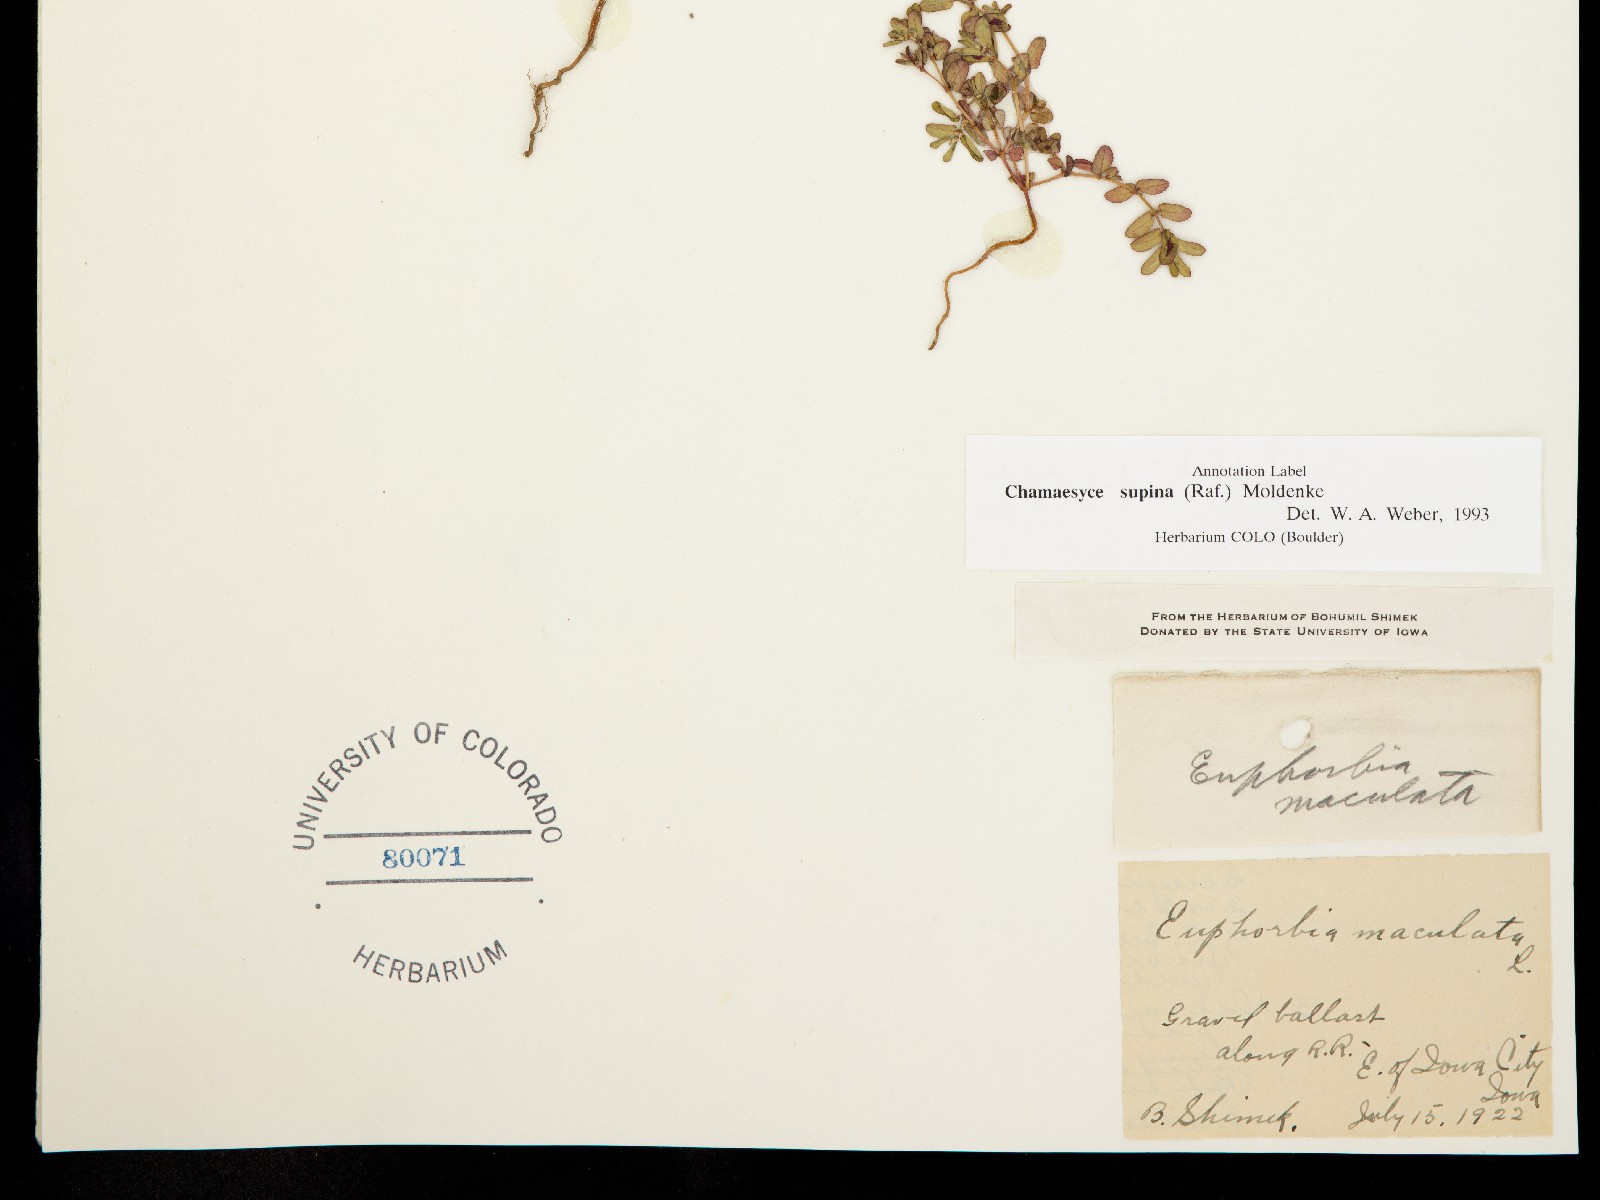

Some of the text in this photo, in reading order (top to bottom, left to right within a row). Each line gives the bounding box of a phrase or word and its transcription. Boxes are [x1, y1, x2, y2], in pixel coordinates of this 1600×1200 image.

[1191, 465, 1307, 477] Annotation Label
[1004, 483, 1325, 503] Chamaesyce supina (Raf.) Moldenke
[1286, 506, 1490, 524] Det. W. A. Weber, 1993
[1155, 531, 1344, 547] Herbarium COLO (Boulder)
[292, 721, 563, 853] UNIVERSITY OF COLORADO
[1190, 745, 1412, 797] Euphorbia
[1275, 769, 1495, 815] maculata
[381, 846, 466, 869] 80071
[1155, 899, 1526, 959] Euphorbia maculata
[352, 939, 508, 984] HERBARIUM
[1161, 998, 1386, 1028] Gravel ballast
[1215, 1035, 1299, 1067] along
[1388, 1047, 1420, 1094] of
[1411, 1043, 1486, 1077] Iowa
[1496, 1034, 1552, 1088] City
[1480, 1070, 1541, 1109] Iowa
[1140, 1100, 1167, 1127] B.
[1348, 1096, 1404, 1132] July
[1456, 1106, 1525, 1126] 1922
